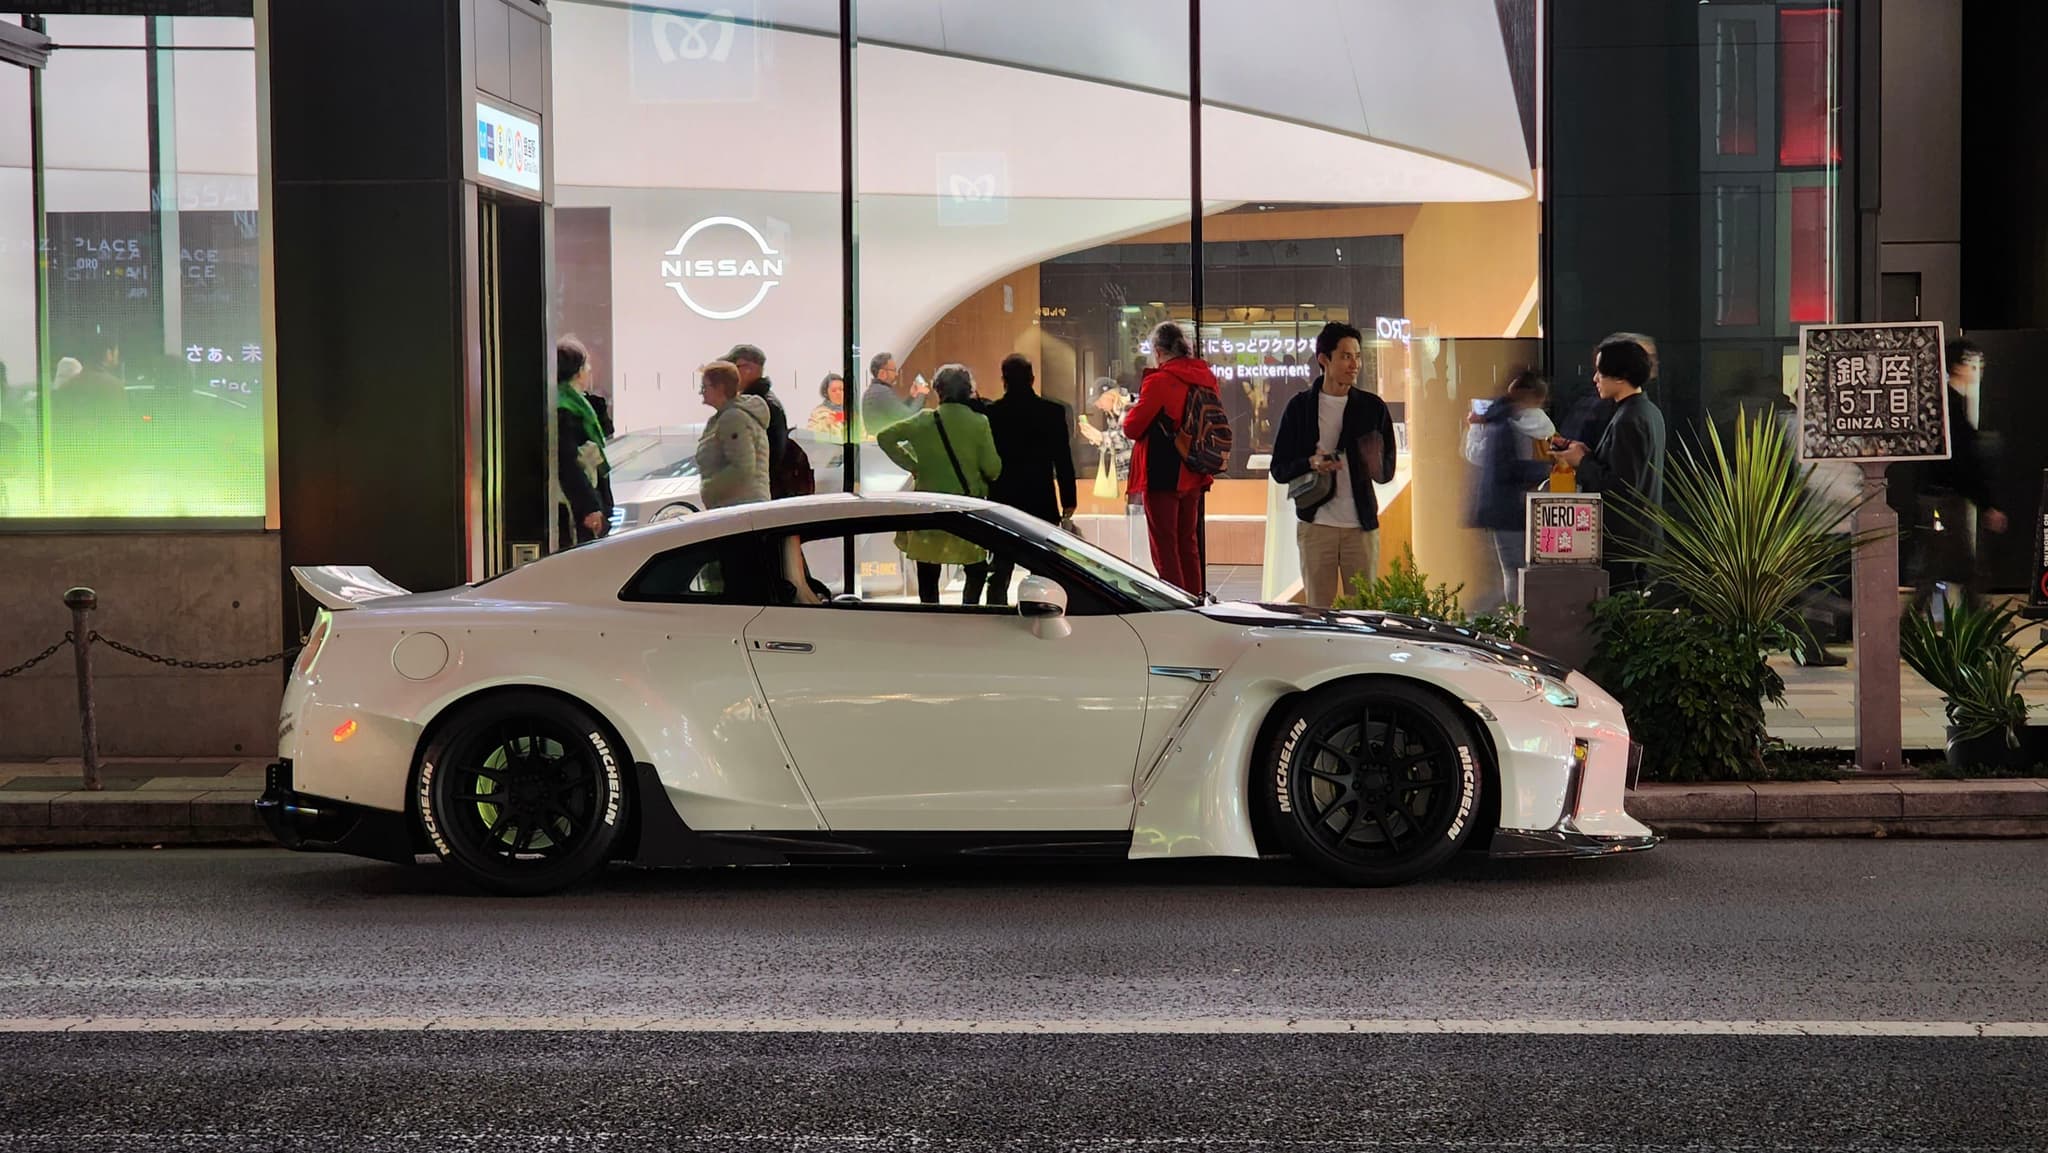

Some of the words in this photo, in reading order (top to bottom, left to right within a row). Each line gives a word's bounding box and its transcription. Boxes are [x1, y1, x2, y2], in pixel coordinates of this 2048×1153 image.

[661, 259, 783, 277] NISSAN
[1237, 363, 1311, 377] Excitement
[1836, 354, 1911, 386] 銀座
[1839, 388, 1908, 414] 5丁目
[1835, 417, 1883, 430] GINZA
[1542, 506, 1575, 527] NERO
[588, 731, 621, 826] MICHELIN
[1276, 718, 1308, 813] MICHELIN
[1447, 745, 1475, 841] MICHELIN
[420, 762, 450, 856] MICHELIN
